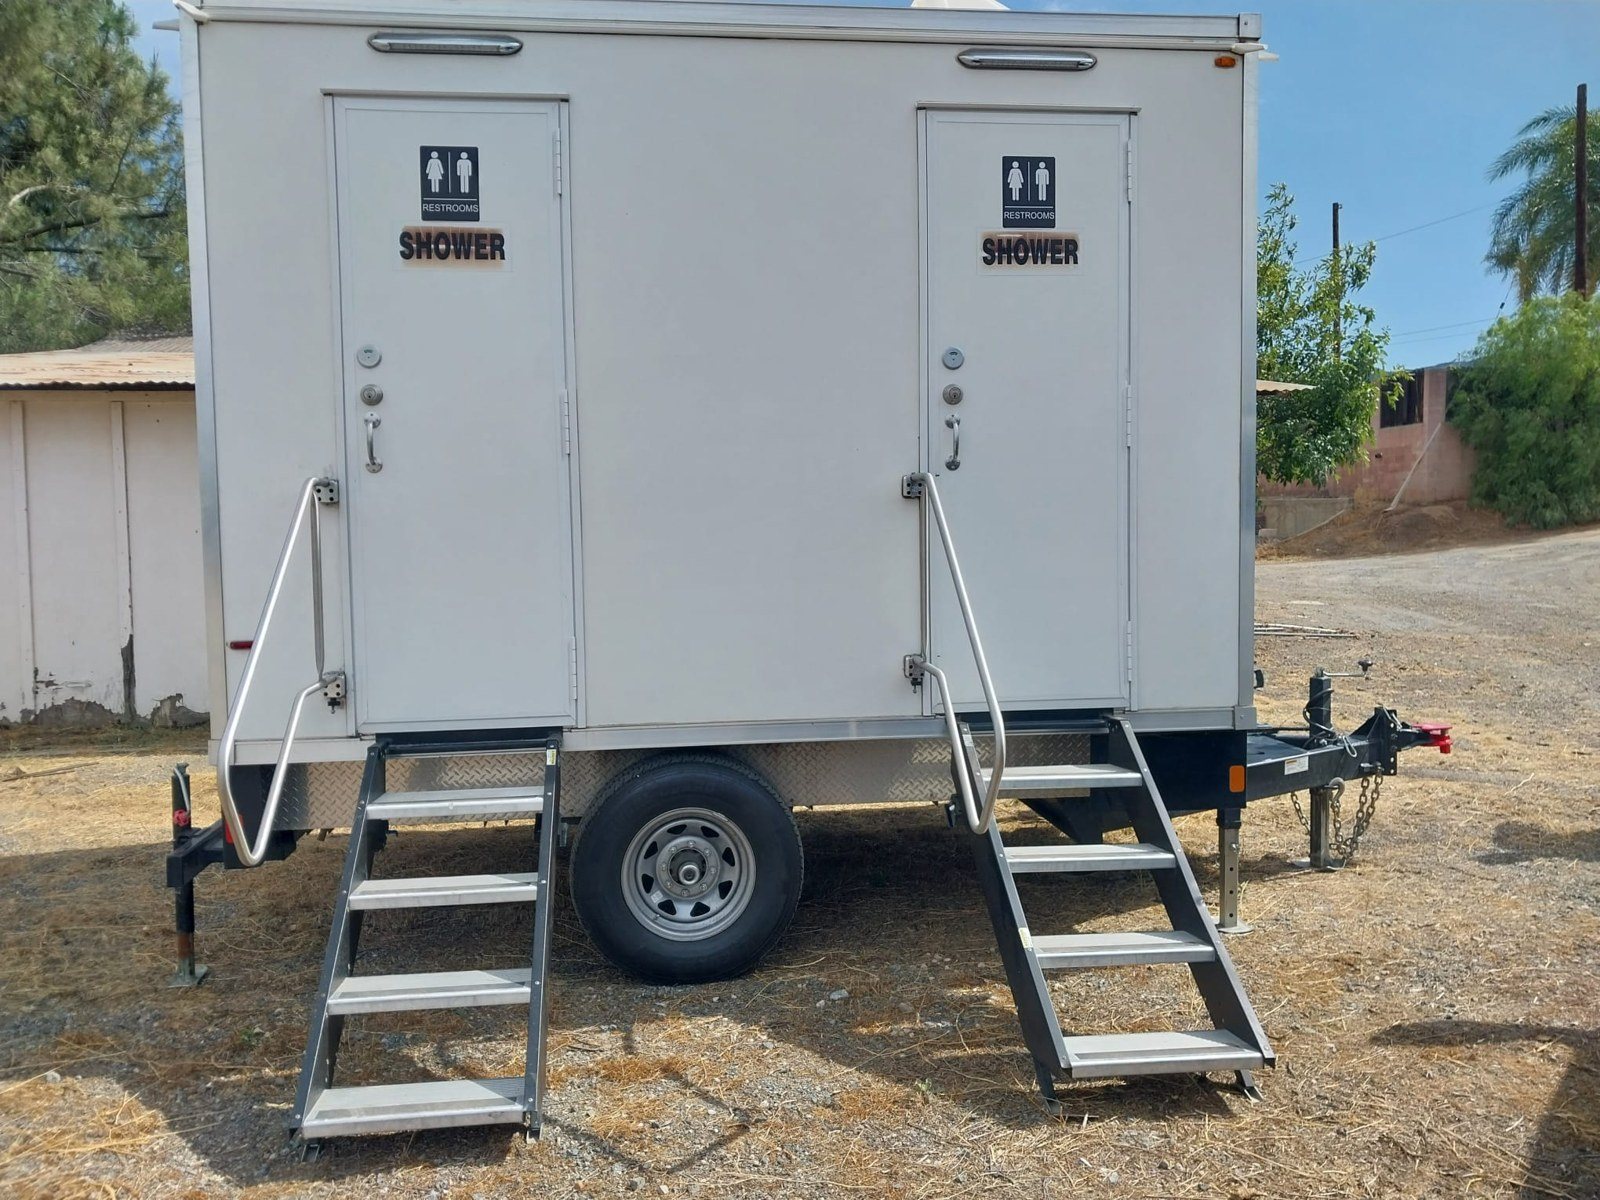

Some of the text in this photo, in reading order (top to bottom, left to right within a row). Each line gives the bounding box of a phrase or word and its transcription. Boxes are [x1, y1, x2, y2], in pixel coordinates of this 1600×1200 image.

[422, 203, 479, 213] RESTROOMS
[1003, 211, 1055, 220] RESTROOMS
[399, 231, 506, 261] SHOWER
[982, 237, 1079, 266] SHOWER
